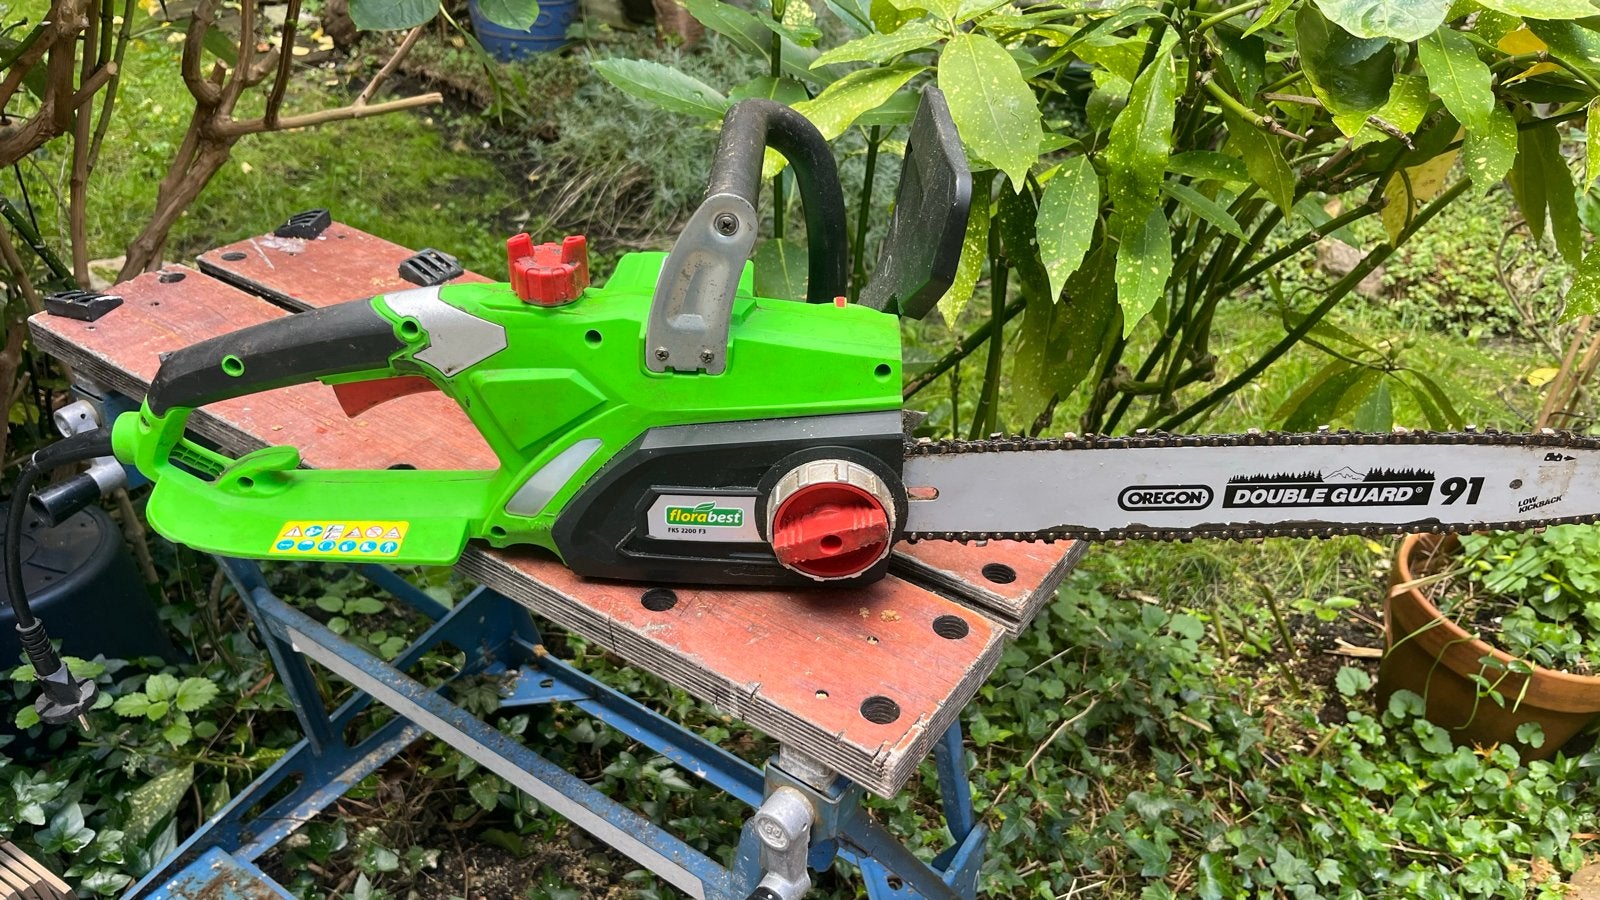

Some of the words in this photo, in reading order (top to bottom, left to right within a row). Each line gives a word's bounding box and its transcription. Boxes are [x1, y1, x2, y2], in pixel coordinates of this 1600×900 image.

[1127, 491, 1203, 505] OREGON
[1232, 488, 1328, 504] DOUBLE
[1440, 477, 1485, 505] 91
[1518, 496, 1538, 507] LOW
[1518, 495, 1563, 514] KICKBACK
[669, 509, 741, 523] florabest
